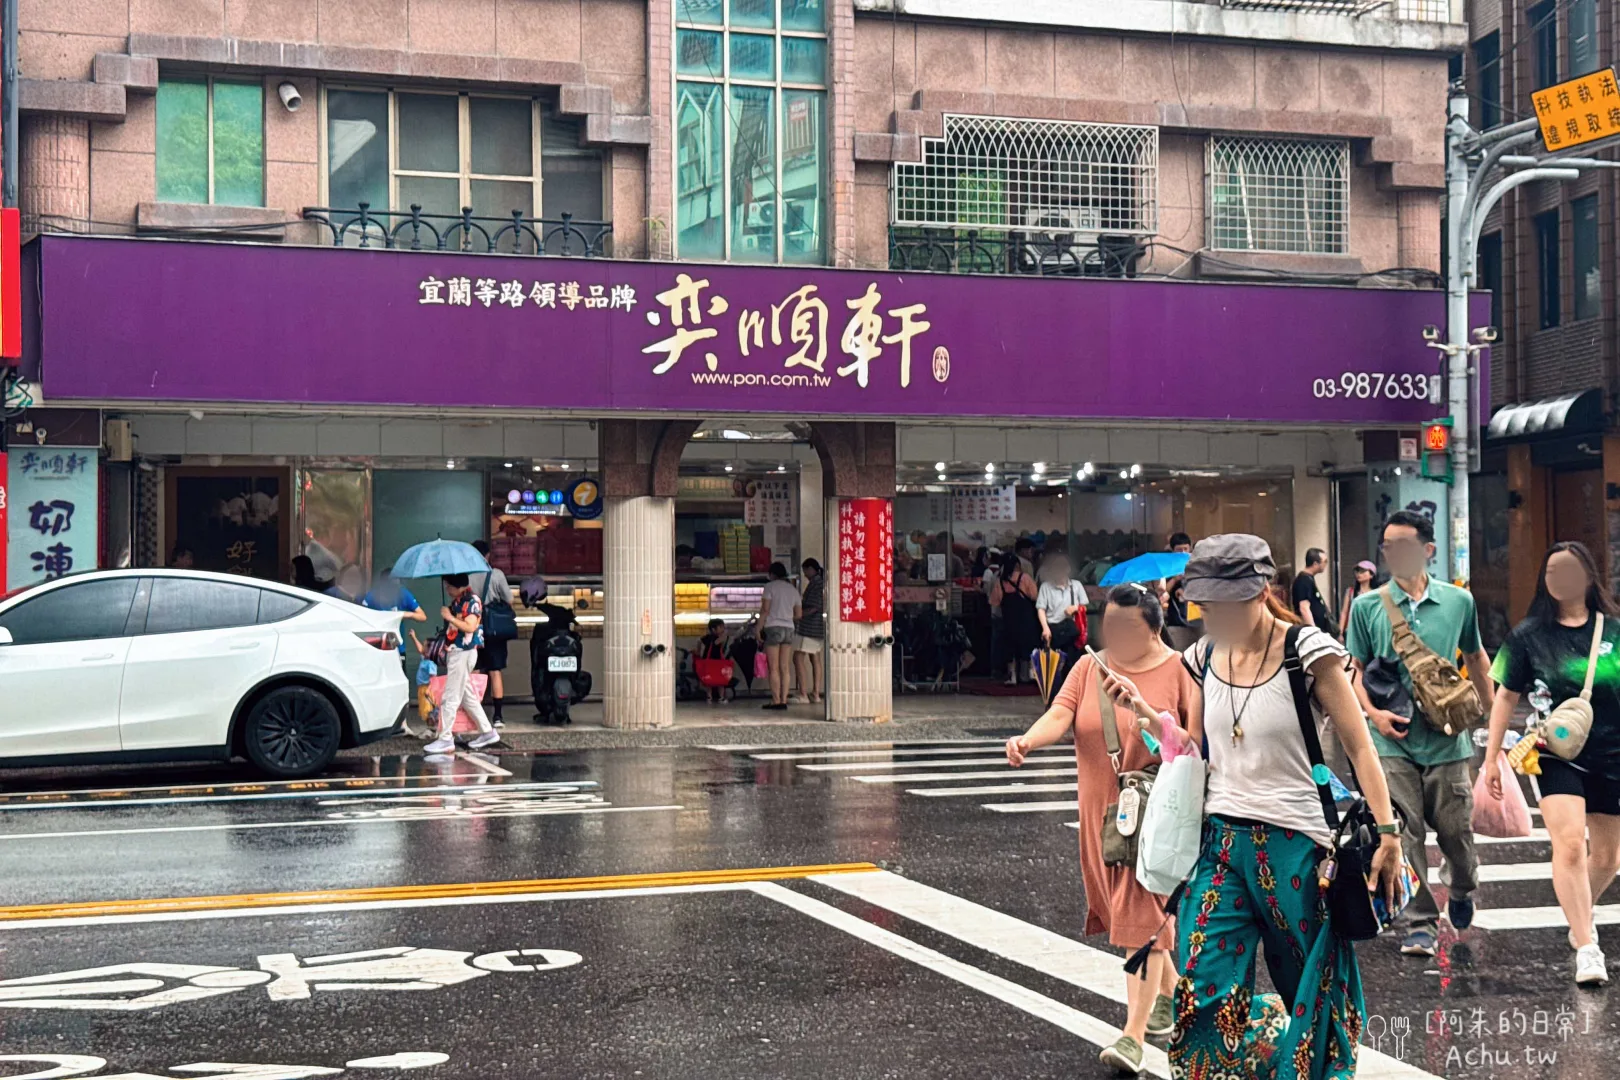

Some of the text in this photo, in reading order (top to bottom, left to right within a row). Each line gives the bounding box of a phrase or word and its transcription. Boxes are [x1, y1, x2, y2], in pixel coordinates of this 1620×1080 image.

[1537, 76, 1616, 116] 科技執法
[418, 276, 638, 312] 宜蘭等路領導品牌
[641, 273, 931, 388] 奕順軒
[691, 371, 832, 388] www.pon.com.tw
[1313, 372, 1430, 400] 03-987633
[20, 452, 88, 474] 奕順軒
[841, 502, 853, 620] 科技執法錄影中
[854, 512, 866, 613] 請勿違規停車
